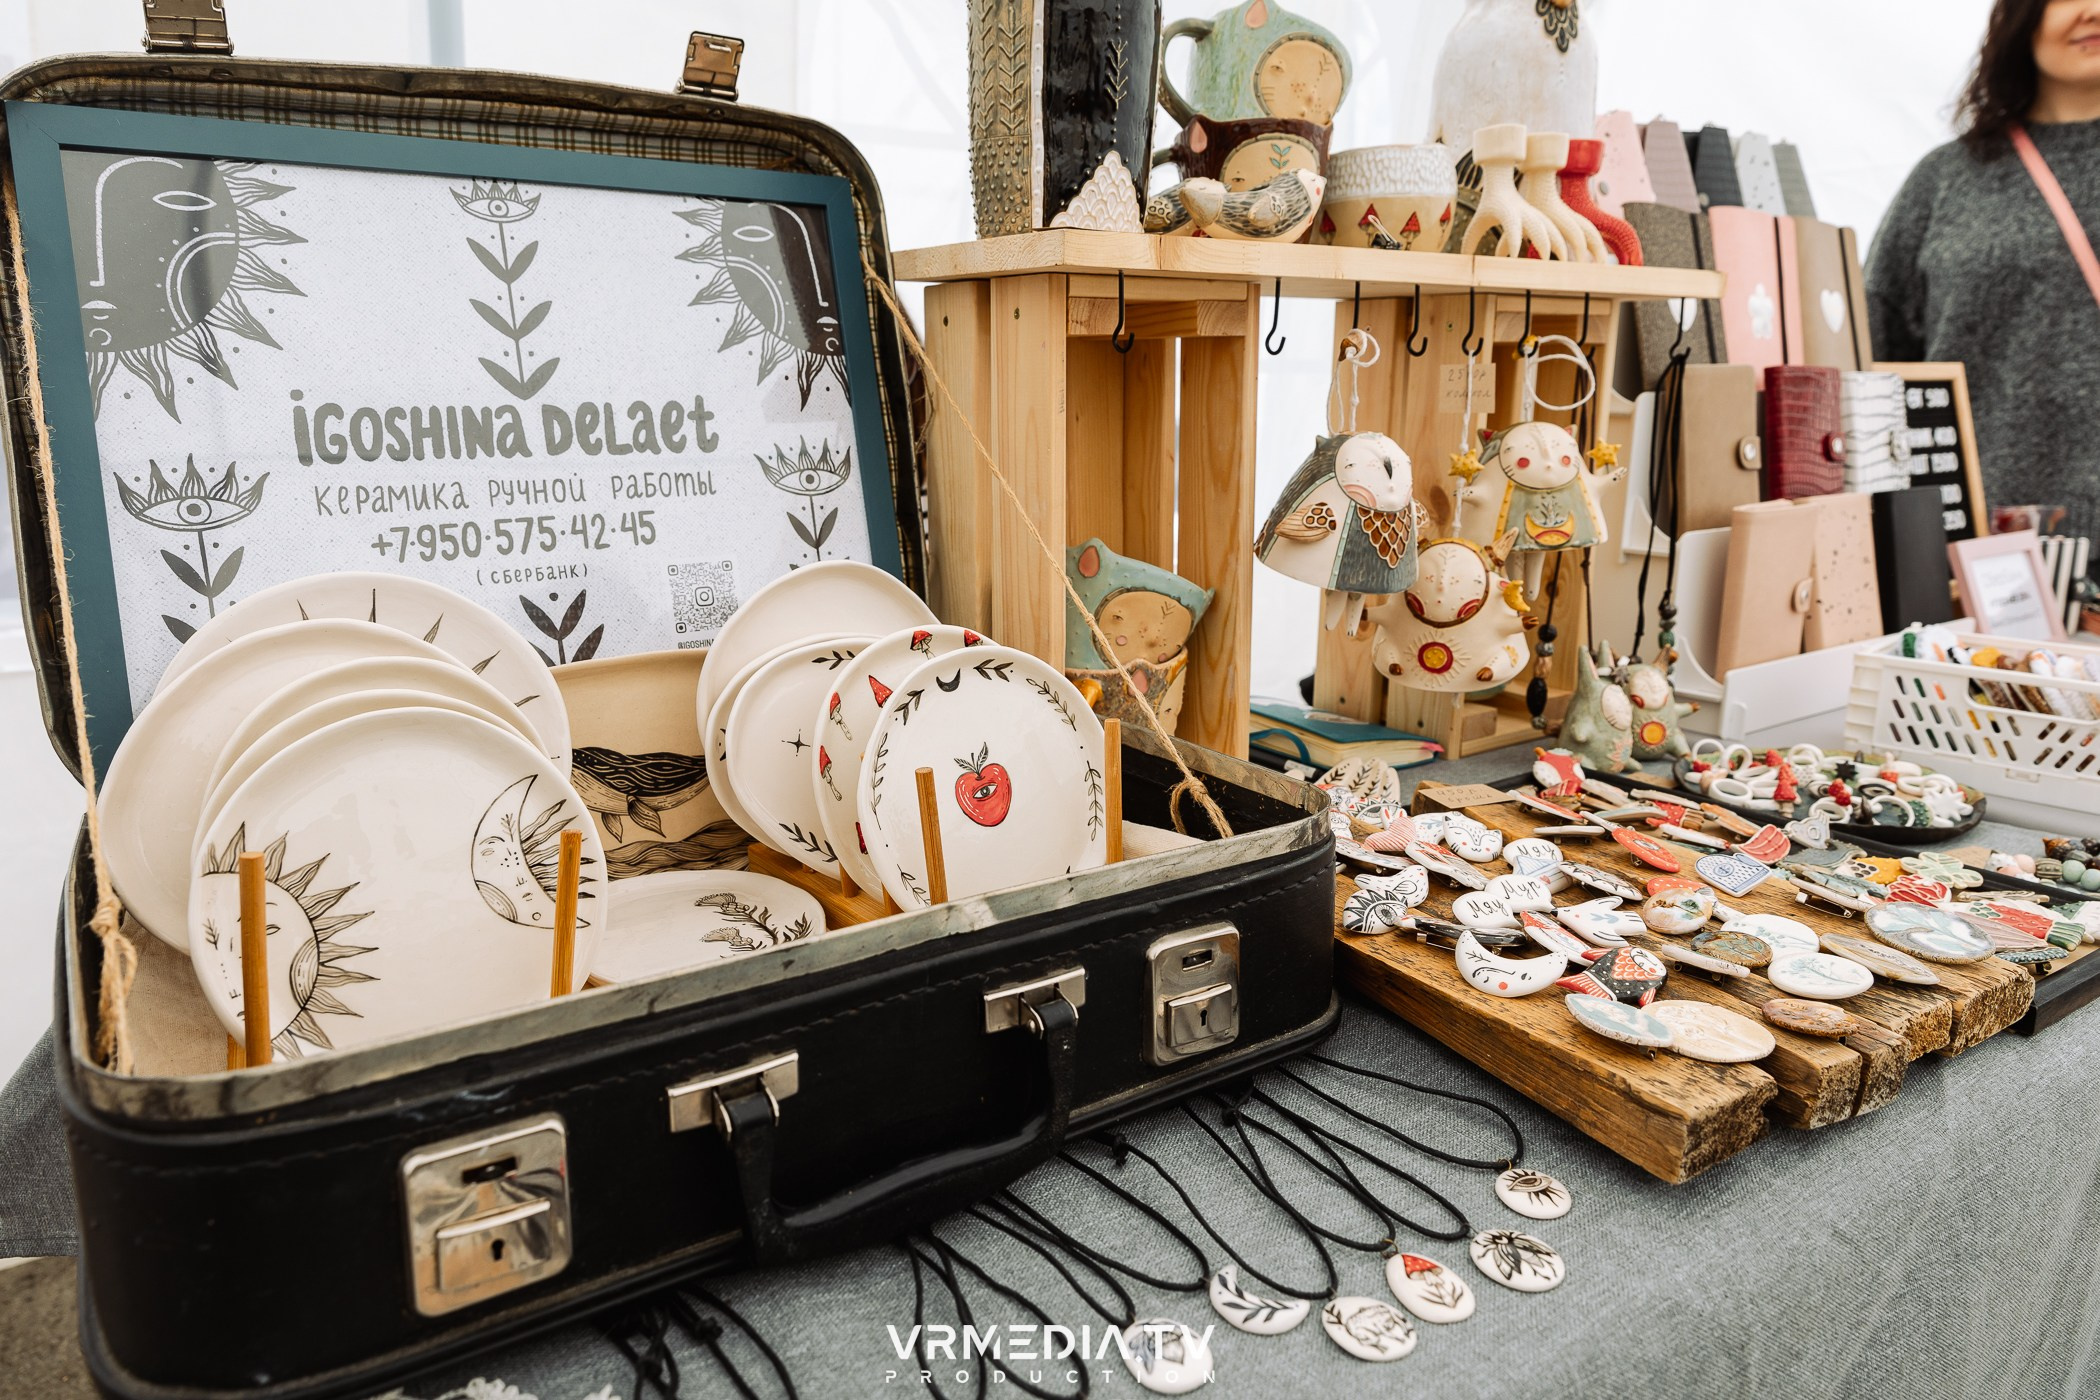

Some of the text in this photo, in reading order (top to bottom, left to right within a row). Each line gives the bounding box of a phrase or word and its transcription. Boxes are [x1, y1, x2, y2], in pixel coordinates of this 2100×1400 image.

[1517, 844, 1558, 861] Мяу
[1501, 879, 1541, 900] Мур
[1467, 898, 1510, 919] Мяу
